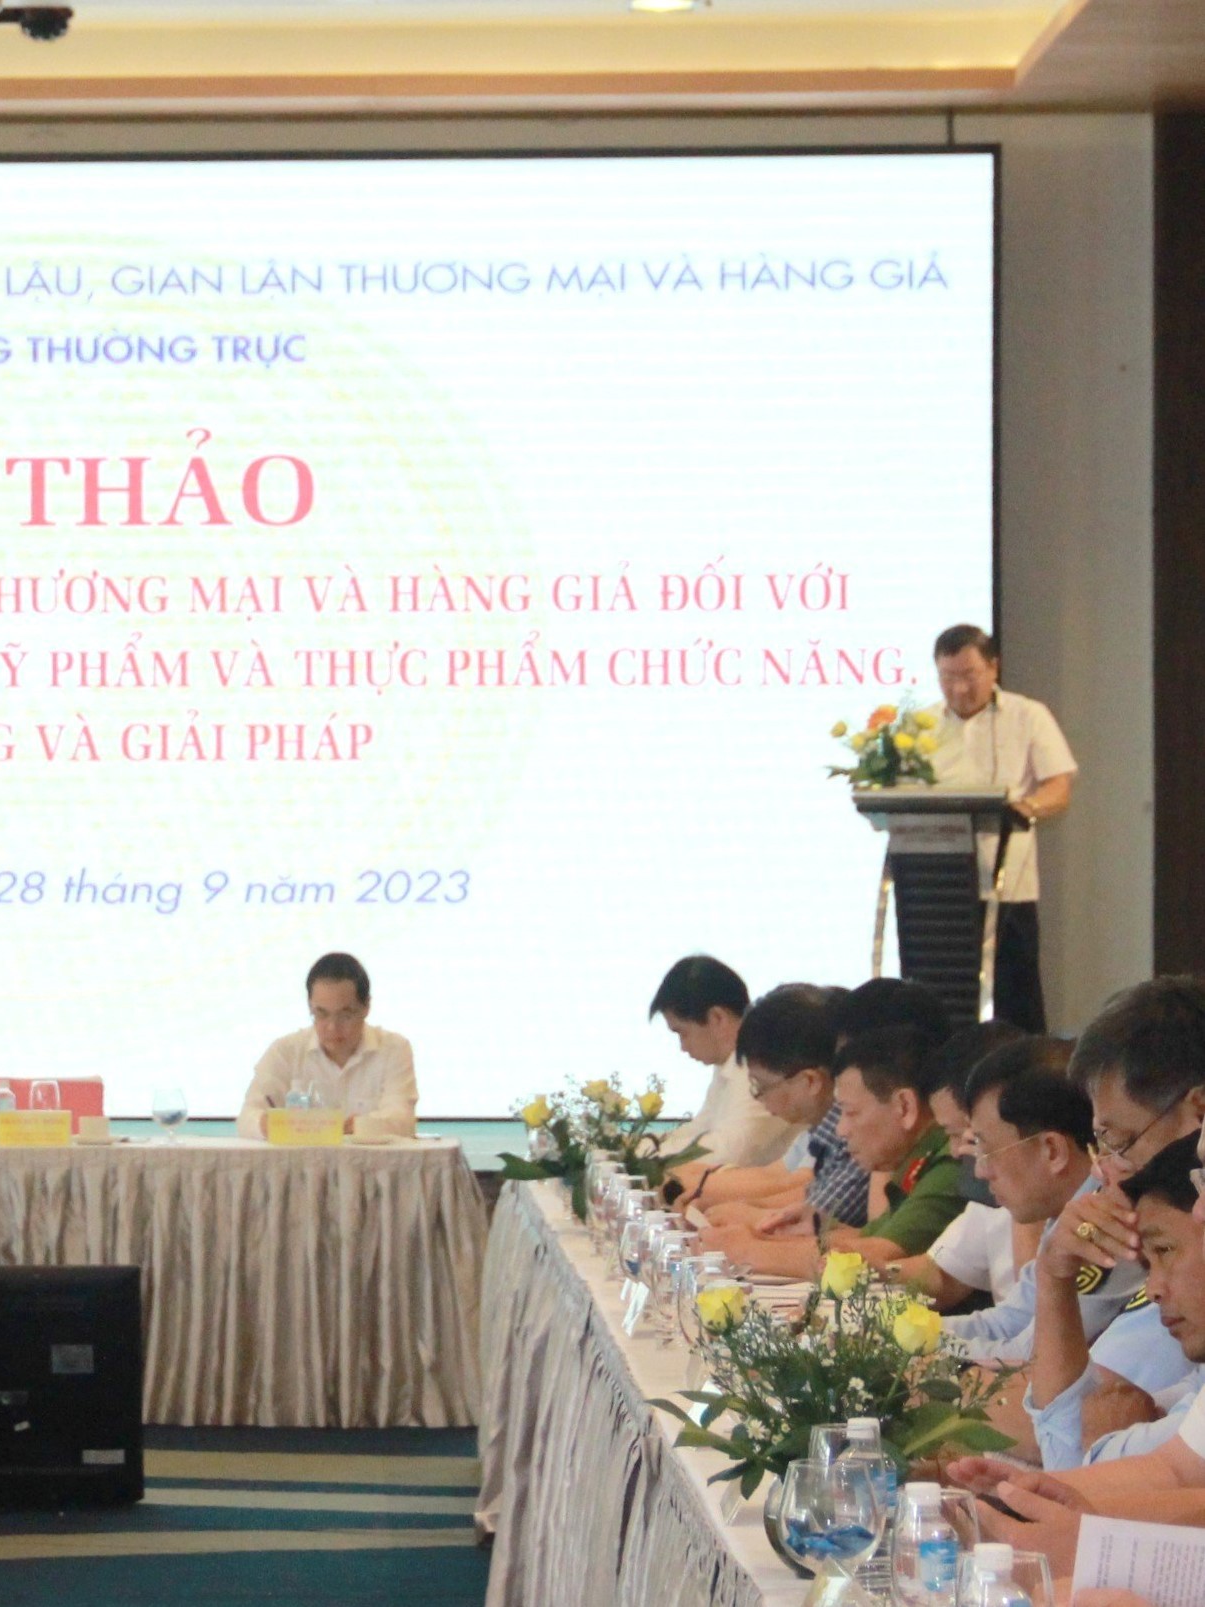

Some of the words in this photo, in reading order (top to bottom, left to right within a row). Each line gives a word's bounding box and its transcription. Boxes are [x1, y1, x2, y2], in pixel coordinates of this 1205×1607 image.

[4, 260, 94, 302] LẬU,
[110, 263, 225, 297] GIAN
[240, 257, 324, 296] LẬN
[337, 259, 534, 296] THƯƠNG
[545, 259, 628, 298] MẠI
[640, 252, 705, 293] VÀ
[717, 251, 857, 293] HÀNG
[867, 249, 950, 292] GIẢ
[26, 327, 199, 366] THƯỜNG
[210, 331, 307, 371] TRỰC
[4, 427, 316, 528] THẢO
[189, 575, 283, 622] MẠI
[303, 564, 368, 613] VÀ
[389, 564, 532, 614] HÀNG
[551, 561, 638, 612] GIẢ
[659, 554, 744, 612] ĐỐI
[765, 561, 849, 611] VỚI
[50, 631, 190, 689] PHẨM
[210, 639, 275, 688] VÀ
[293, 640, 428, 696] THỰC
[446, 631, 588, 687] PHẨM
[607, 637, 742, 687] CHỨC
[762, 639, 917, 686] NĂNG.
[35, 712, 101, 762] VÀ
[120, 709, 225, 762] GIẢI
[246, 712, 374, 762] PHÁP
[63, 866, 184, 916] tháng
[201, 869, 231, 905] 9
[243, 875, 336, 905] năm
[354, 867, 472, 906] 2023
